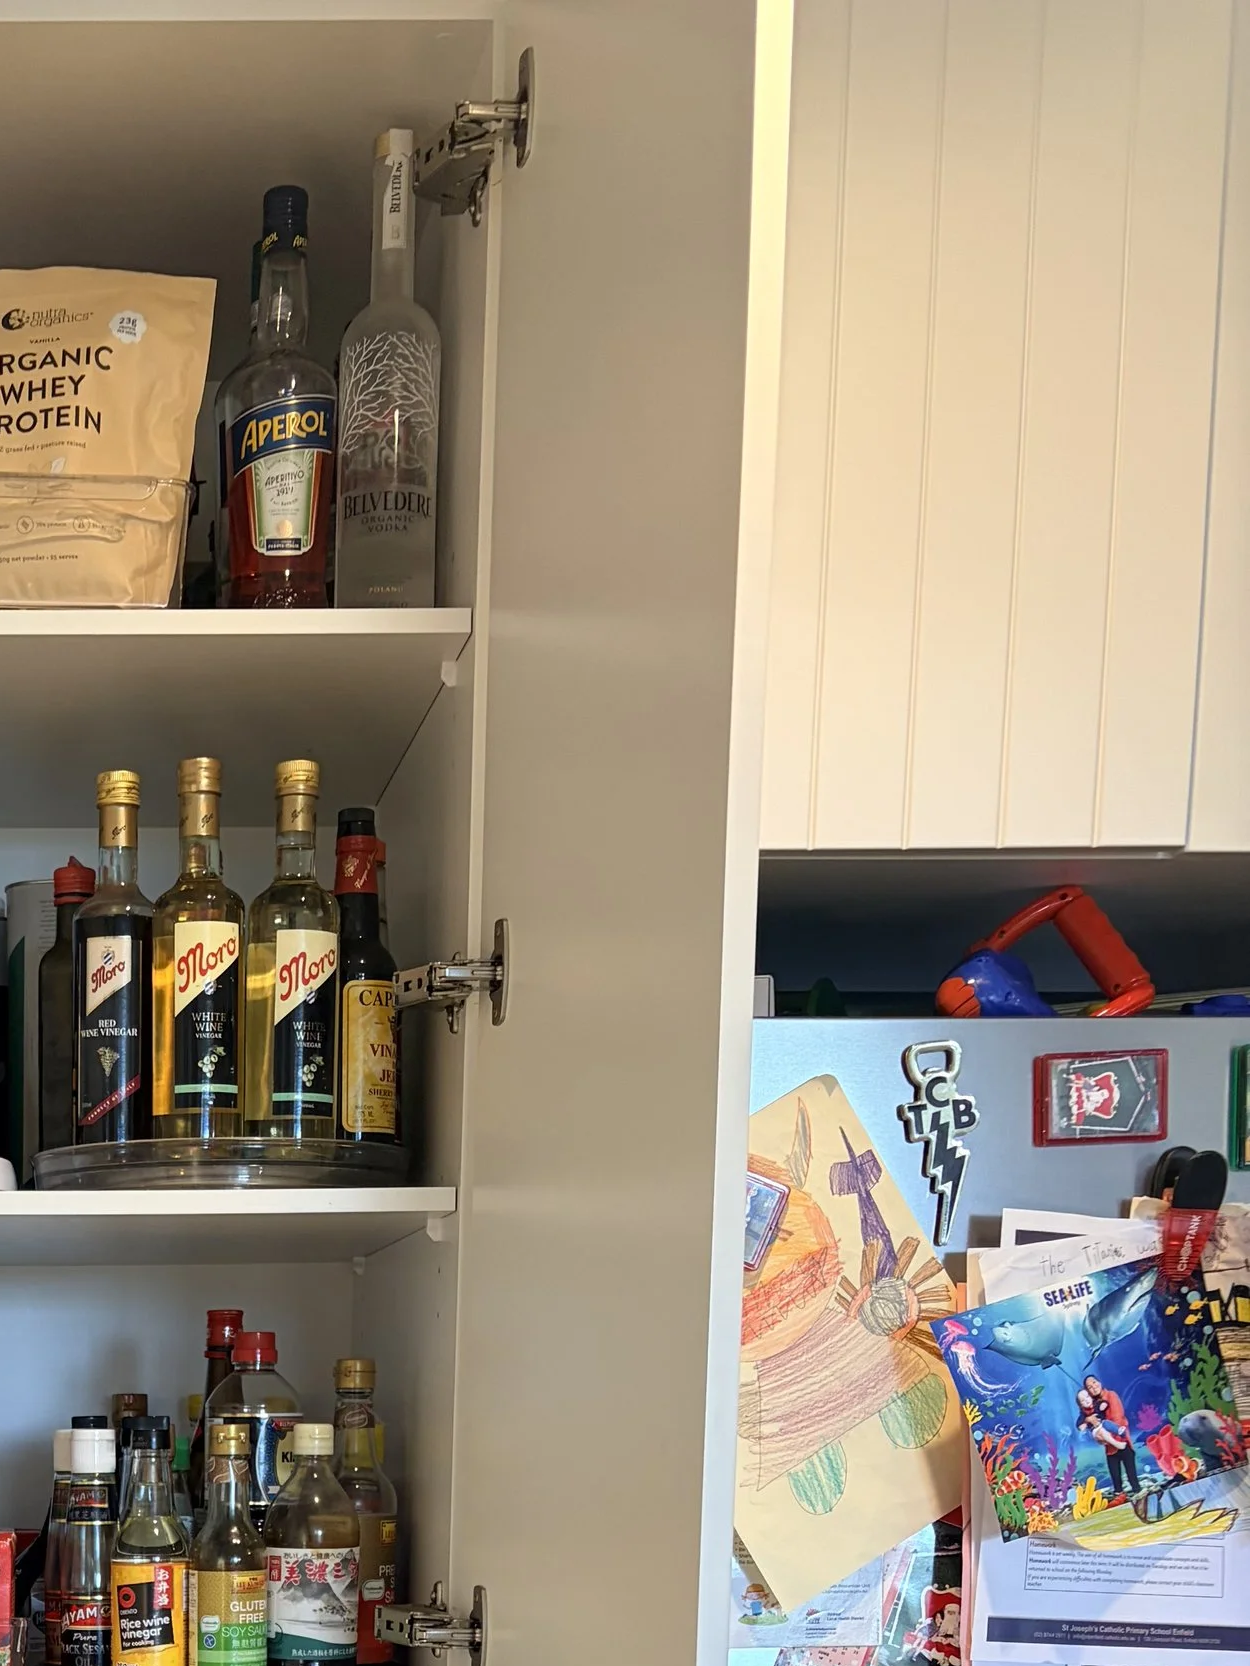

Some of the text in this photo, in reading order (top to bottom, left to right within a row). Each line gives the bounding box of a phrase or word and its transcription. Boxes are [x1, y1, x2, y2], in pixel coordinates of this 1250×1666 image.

[119, 316, 138, 329] 23g
[0, 374, 86, 406] WHEY
[241, 410, 328, 459] APEROL
[264, 469, 305, 487] APERITIVO
[344, 490, 432, 520] BELVEDERE
[361, 515, 415, 525] ORGANIC
[368, 525, 408, 533] VODKA
[22, 554, 45, 563] powder
[177, 937, 236, 993] Moro
[91, 961, 125, 993] Moro
[279, 948, 336, 1001] Moro
[192, 1012, 227, 1022] WHITE
[98, 1019, 116, 1028] RED
[195, 1022, 223, 1032] WINE
[292, 1021, 326, 1032] WHITE
[81, 1027, 138, 1038] WINE VINEGAR
[195, 1031, 222, 1039] VINEGAR
[296, 1031, 321, 1041] WINE
[1177, 1215, 1202, 1272] CHOPTANK
[1043, 1287, 1066, 1307] SEA
[70, 1491, 96, 1506] AYAM
[1030, 1540, 1056, 1548] Homework
[156, 1568, 170, 1607] お弁当
[62, 1606, 97, 1631] AYAM
[121, 1614, 170, 1631] Rice wine
[239, 1613, 264, 1624] FREE
[122, 1626, 162, 1640] vinegar
[222, 1626, 247, 1637] SOY
[1062, 1624, 1069, 1632] St
[1070, 1624, 1098, 1634] Joseph's
[1099, 1626, 1124, 1634] Catholic
[1126, 1626, 1149, 1635] Primary
[1173, 1628, 1194, 1636] Enfield
[72, 1633, 97, 1641] Pure
[131, 1639, 155, 1647] cooking
